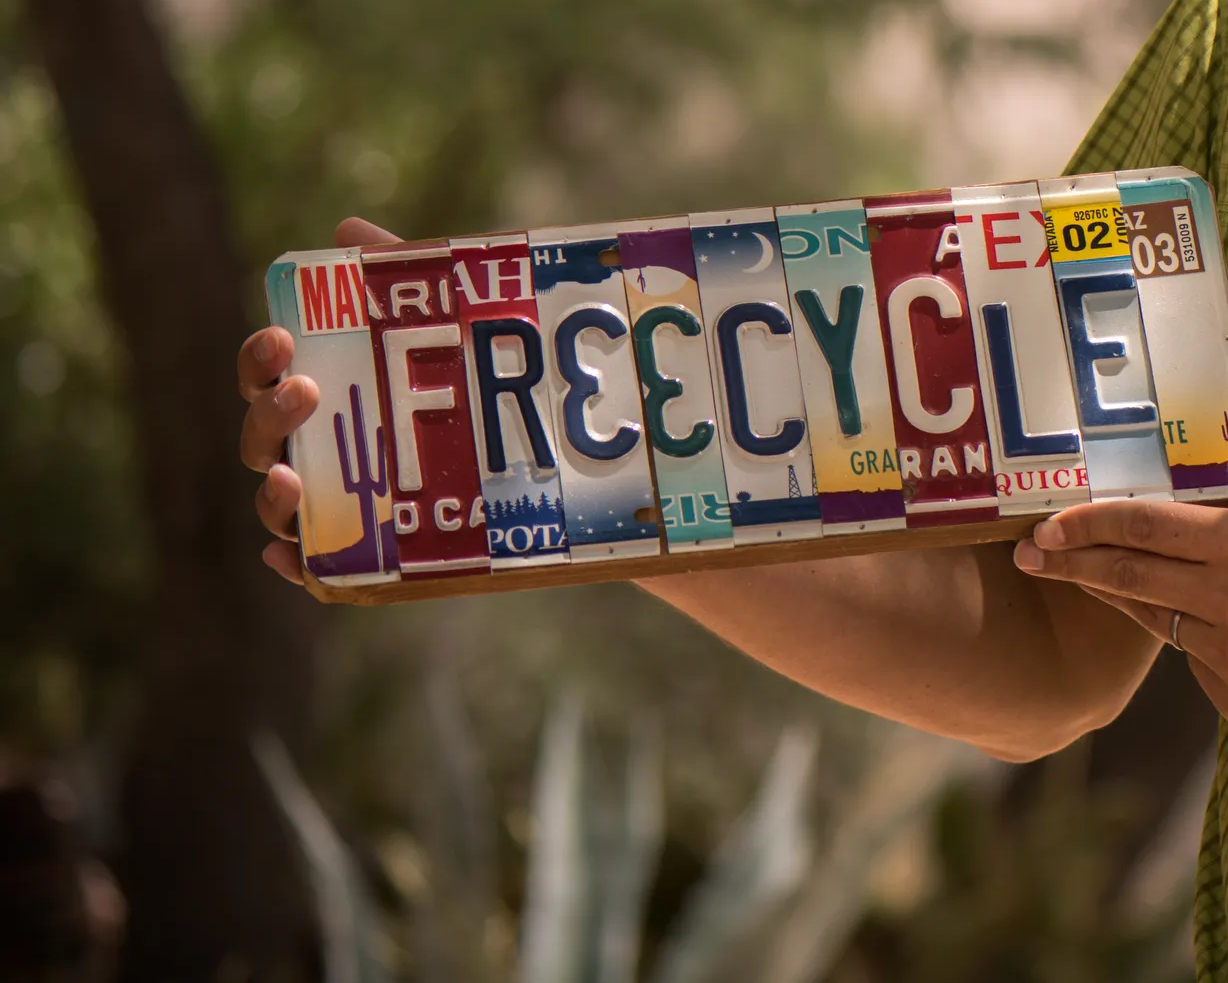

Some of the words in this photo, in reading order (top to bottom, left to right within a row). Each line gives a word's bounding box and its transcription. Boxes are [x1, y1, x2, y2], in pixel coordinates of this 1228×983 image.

[1073, 208, 1109, 222] 92676C
[1123, 211, 1148, 231] AZ
[1176, 212, 1187, 221] N
[1044, 216, 1060, 253] NEVADA
[1062, 221, 1113, 252] 02
[1179, 223, 1195, 262] 531009
[1132, 232, 1180, 275] 03
[382, 272, 1158, 492] FREECYCLE
[850, 448, 901, 475] GRA
[899, 442, 987, 480] RAN
[994, 467, 1089, 496] QUICE
